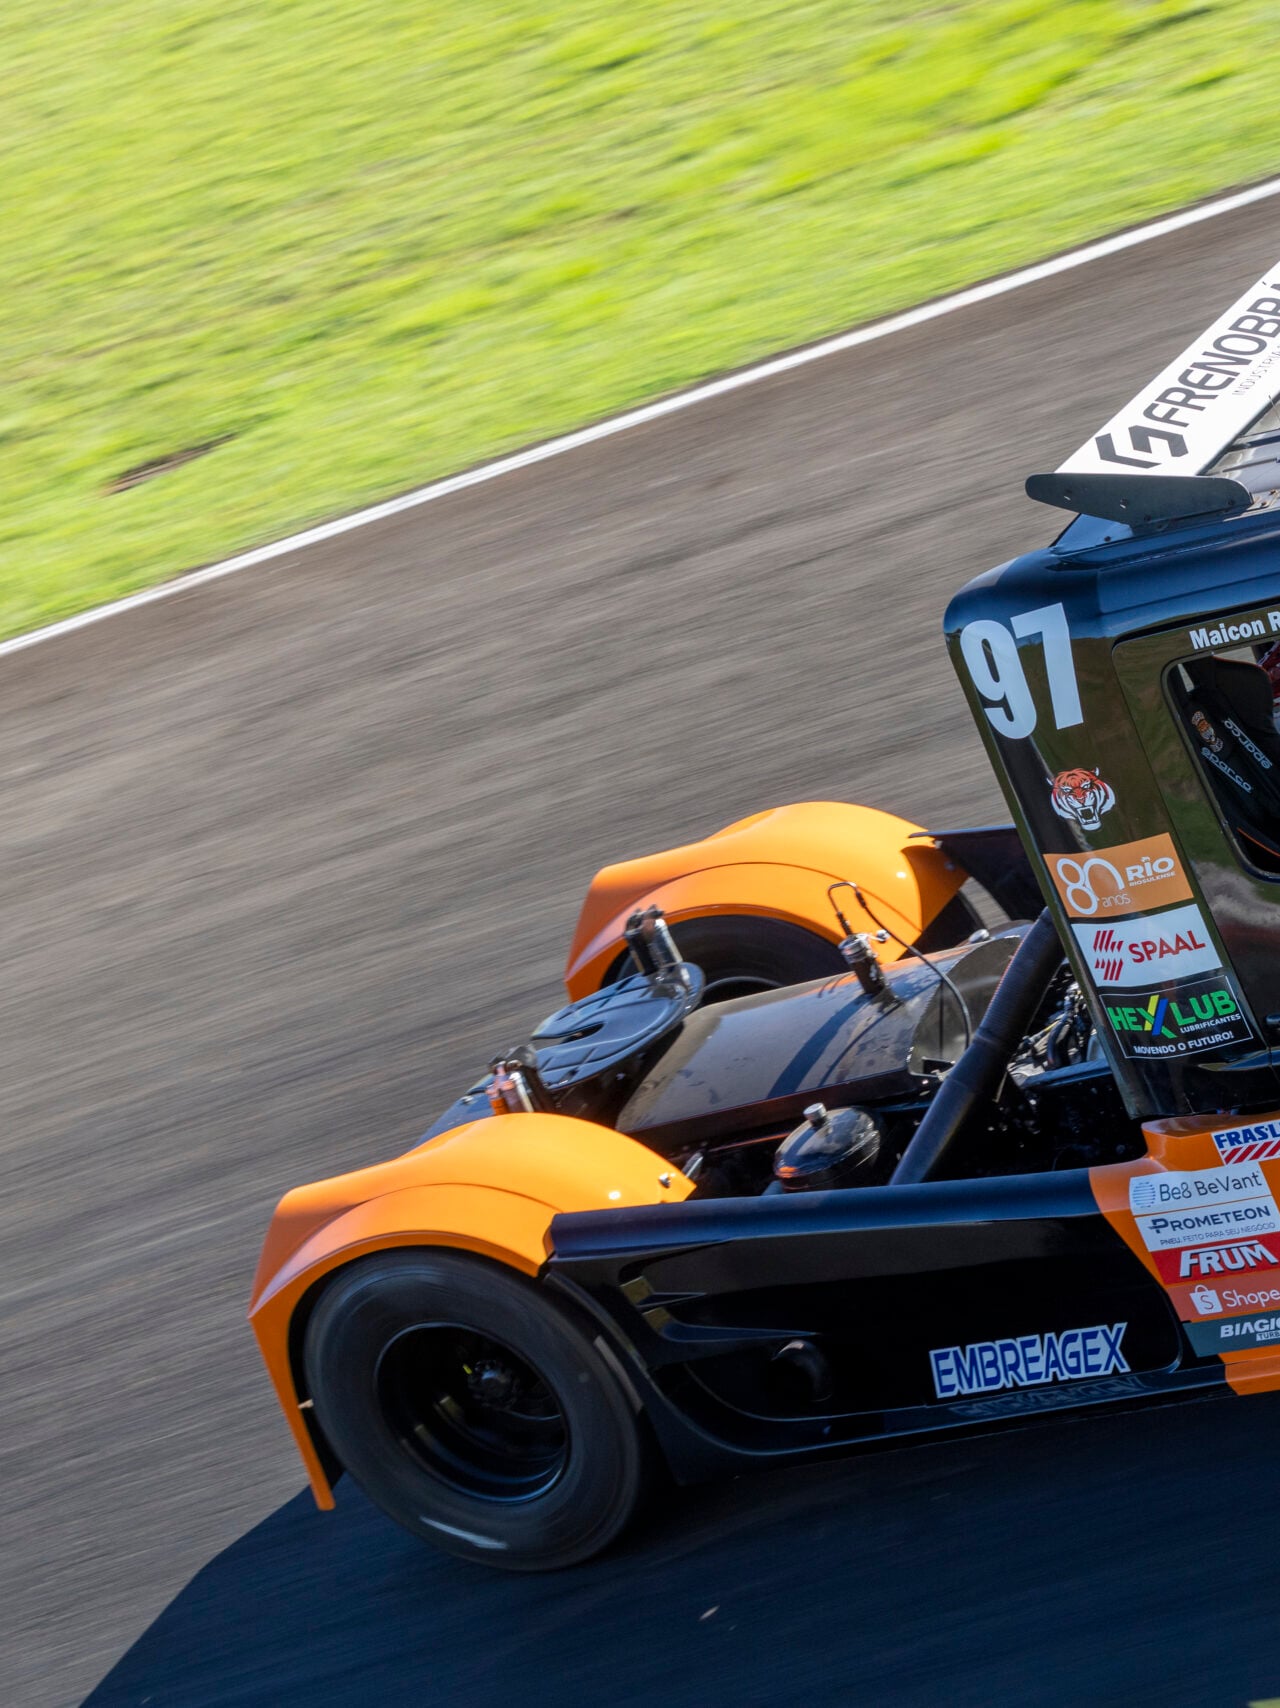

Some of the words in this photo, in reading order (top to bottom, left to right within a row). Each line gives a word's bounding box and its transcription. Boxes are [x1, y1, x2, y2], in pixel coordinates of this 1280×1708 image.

[1189, 619, 1267, 650] Maicon
[960, 602, 1084, 740] 97
[1101, 893, 1132, 908] anos
[1128, 930, 1206, 964] SPAAL
[1180, 1013, 1242, 1034] LUBRIFICANTES
[1134, 1043, 1176, 1056] MOVENDO
[1177, 1041, 1187, 1051] O
[1188, 1031, 1235, 1048] FUTURO!
[1159, 1181, 1192, 1202] Be8
[1194, 1172, 1262, 1196] BeVant
[1149, 1205, 1271, 1234] PROMETEON
[1205, 1230, 1224, 1239] PARA
[1225, 1228, 1241, 1236] SEU
[1180, 1240, 1279, 1278] FRUM
[930, 1323, 1131, 1397] EMBREAGEX
